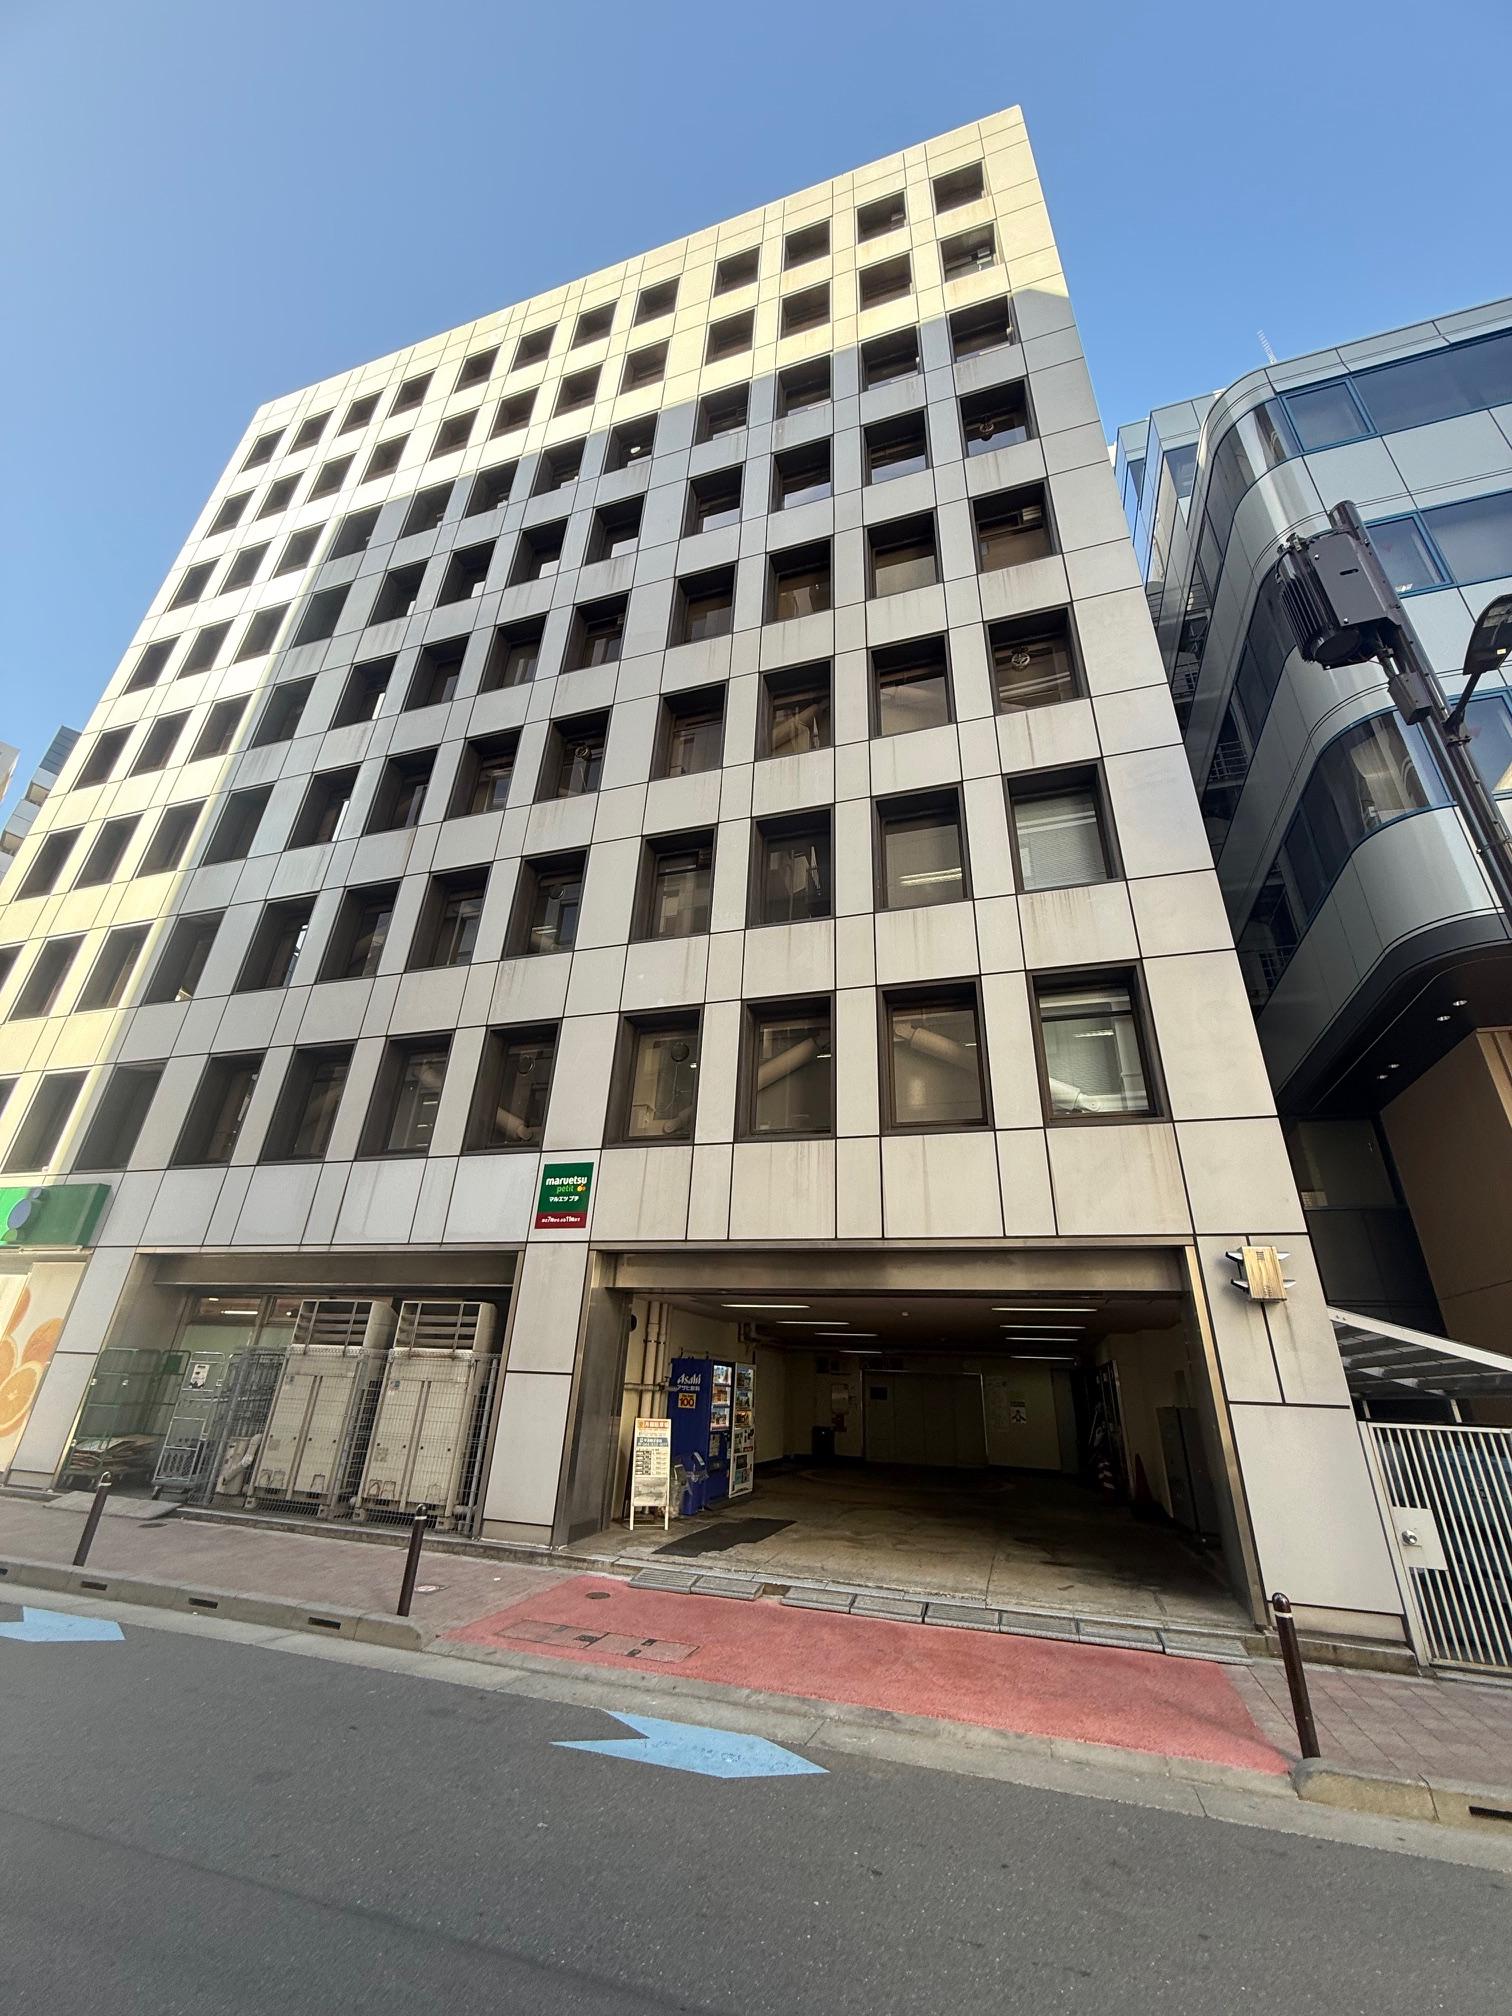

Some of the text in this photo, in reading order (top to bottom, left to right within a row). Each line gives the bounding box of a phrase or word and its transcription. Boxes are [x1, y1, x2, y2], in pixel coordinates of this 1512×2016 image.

[546, 1176, 587, 1185] maruetsu
[557, 1185, 574, 1194] petit
[677, 1373, 702, 1385] Asahi
[680, 1398, 694, 1407] 100
